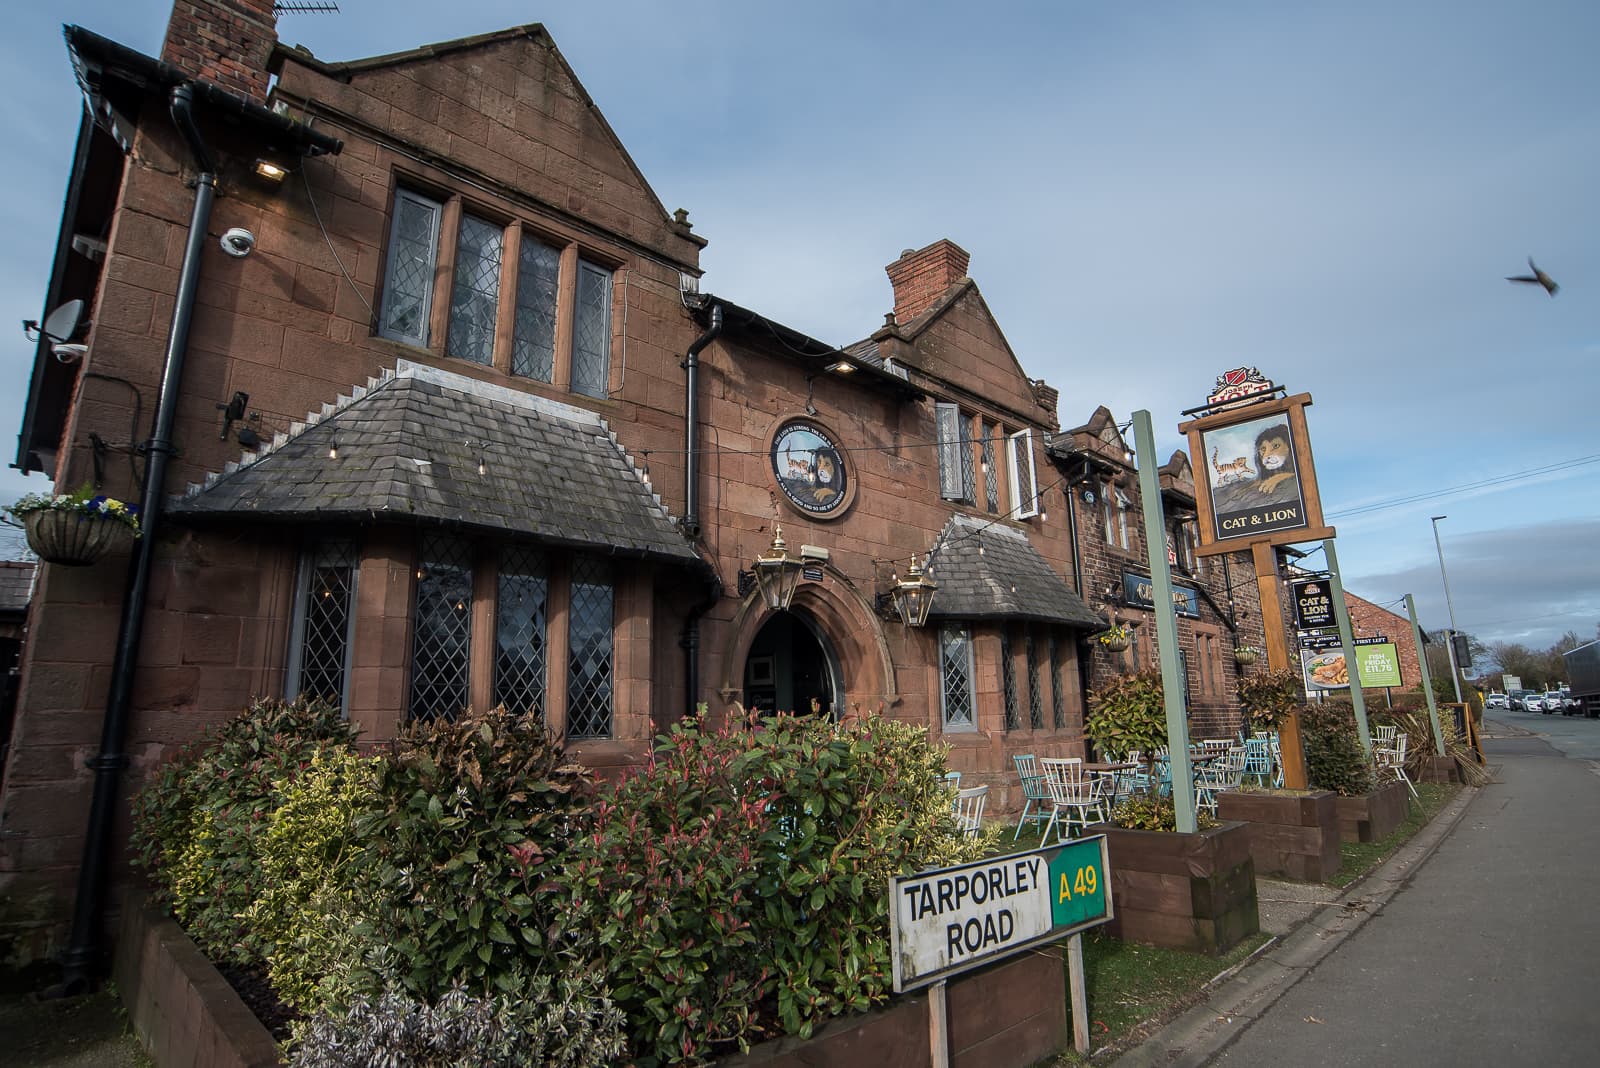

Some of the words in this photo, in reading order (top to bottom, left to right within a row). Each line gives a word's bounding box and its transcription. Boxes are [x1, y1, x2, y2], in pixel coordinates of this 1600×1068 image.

[1223, 517, 1247, 530] CAT
[1250, 514, 1262, 525] &
[1265, 508, 1297, 523] LION
[1300, 597, 1320, 606] CAT
[1320, 595, 1330, 605] &
[1303, 605, 1328, 615] LION
[904, 858, 1041, 922] TARPORLEY
[946, 909, 1014, 959] ROAD
